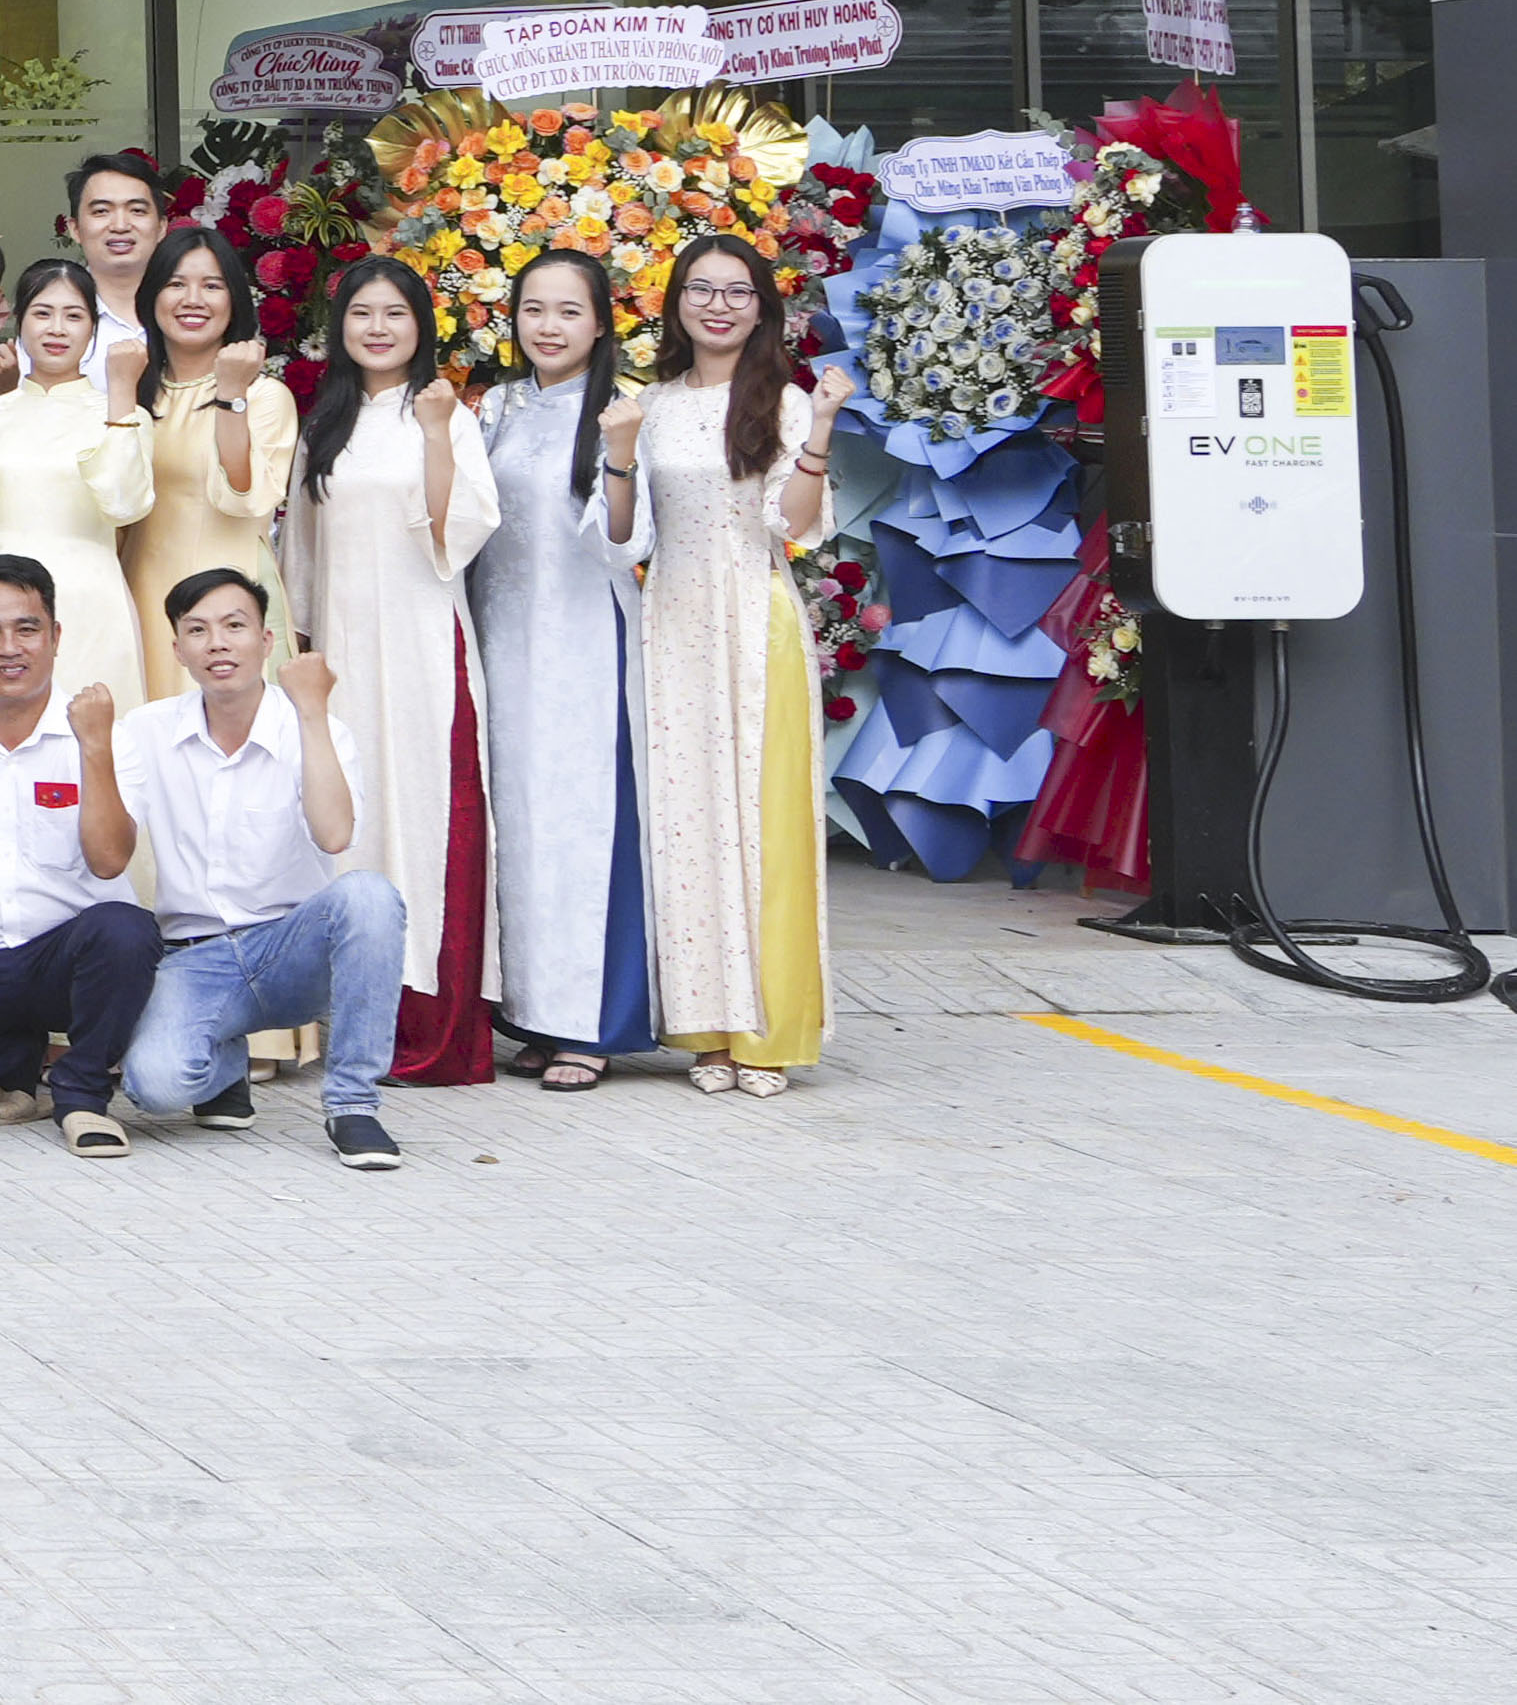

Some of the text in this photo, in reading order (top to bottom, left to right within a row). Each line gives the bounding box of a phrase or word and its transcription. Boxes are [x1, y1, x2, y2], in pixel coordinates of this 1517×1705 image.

[504, 13, 685, 47] TẬP ĐOÀN KIM TÍN
[706, 16, 734, 41] ÔNG
[1189, 435, 1322, 456] EV ONE
